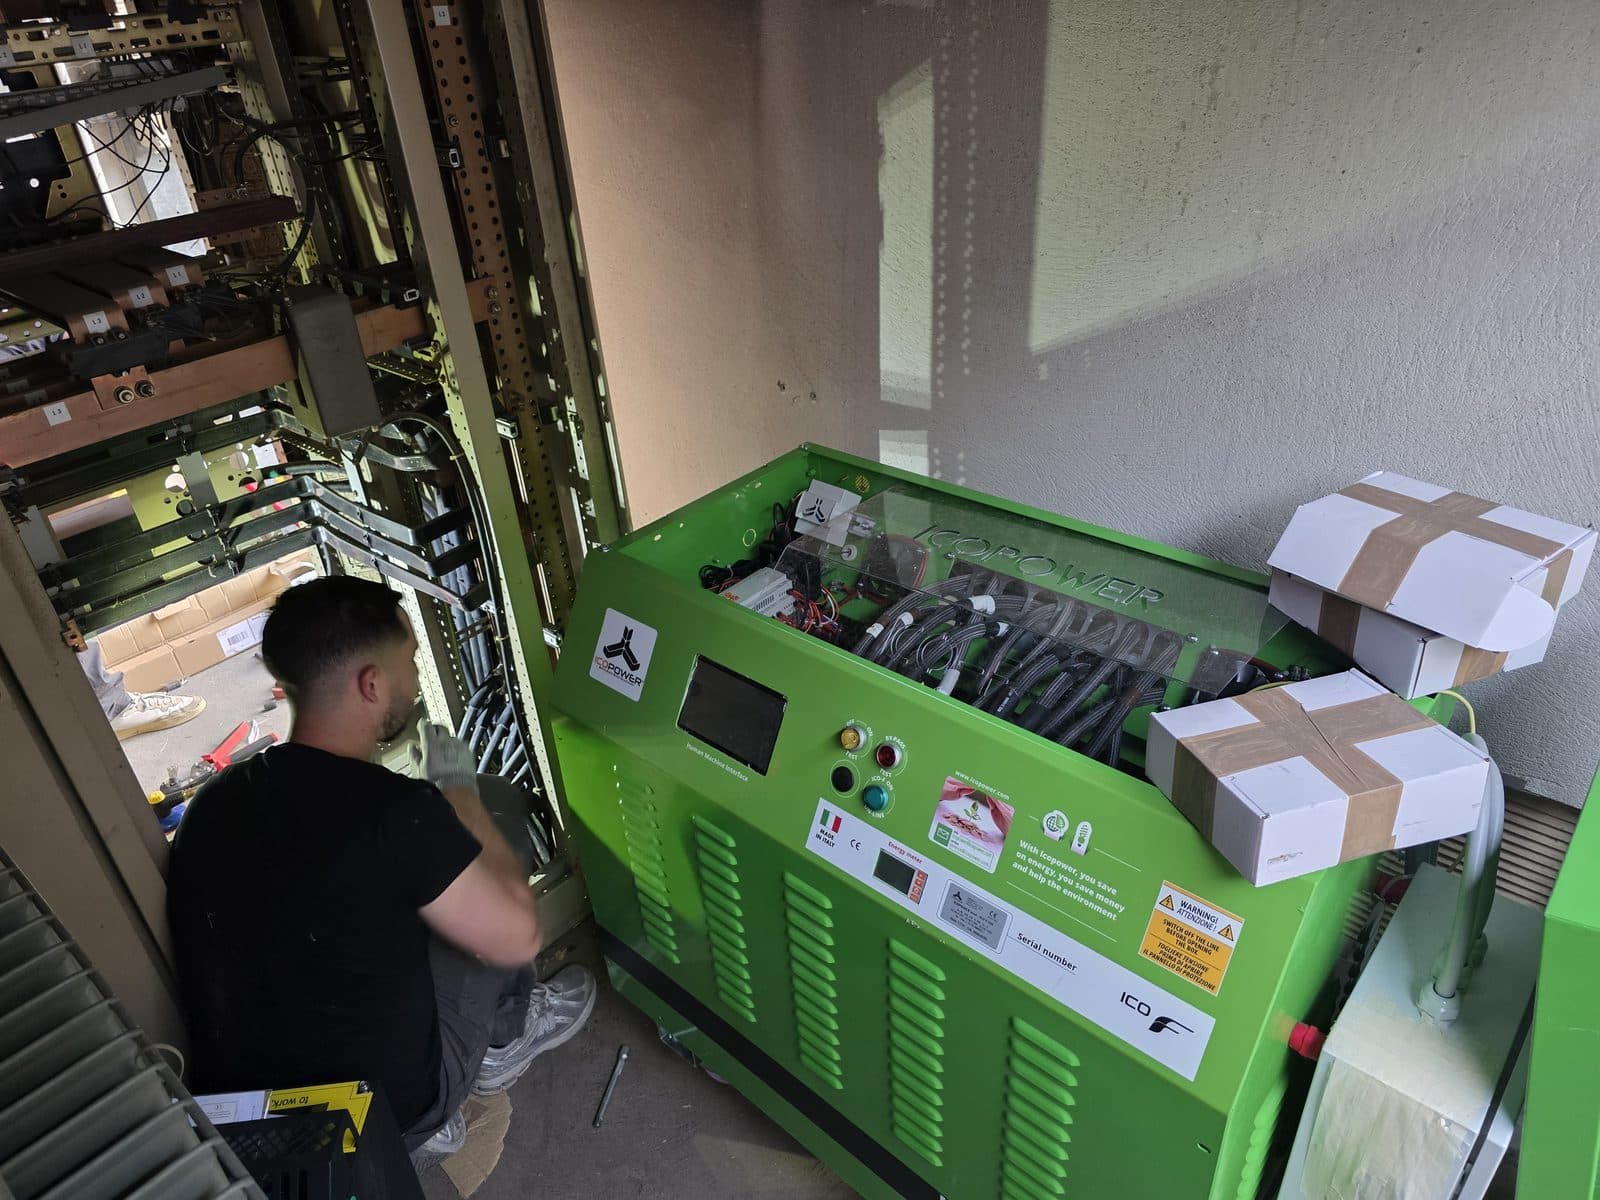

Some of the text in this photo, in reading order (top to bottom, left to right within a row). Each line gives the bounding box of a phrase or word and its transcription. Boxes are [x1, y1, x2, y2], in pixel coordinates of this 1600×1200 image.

[913, 524, 1165, 613] ICOPOWER
[595, 656, 642, 687] ICOPOWER
[845, 750, 858, 760] TEST
[885, 735, 906, 750] BYPASS
[704, 752, 725, 769] Machine
[725, 764, 749, 782] Interface
[880, 768, 892, 778] TEST
[955, 770, 1010, 800] www.icopower.com
[816, 832, 836, 848] IN ITALY
[820, 828, 835, 840] MADE
[888, 841, 922, 864] Energy meter
[1016, 850, 1126, 913] on energy, you save money
[1020, 840, 1118, 896] With Icopower, you save
[1012, 861, 1118, 920] and help the environment
[1176, 908, 1217, 932] ATTENZIONE!
[1180, 900, 1219, 924] WARNING!
[1163, 918, 1220, 953] SWITCH OFF THE LINE
[1166, 927, 1212, 956] BEFORE OPENING
[1175, 939, 1198, 955] THE BOX
[1017, 932, 1078, 972] Serial number
[1158, 942, 1209, 973] TOGLIERE TENSIONE
[1158, 950, 1176, 963] PRIMA
[1183, 962, 1204, 978] APRIRE
[1148, 952, 1176, 970] PANNELLO
[1182, 968, 1216, 992] PROTEZIONE
[1120, 992, 1152, 1016] ICO
[299, 1095, 309, 1104] to
